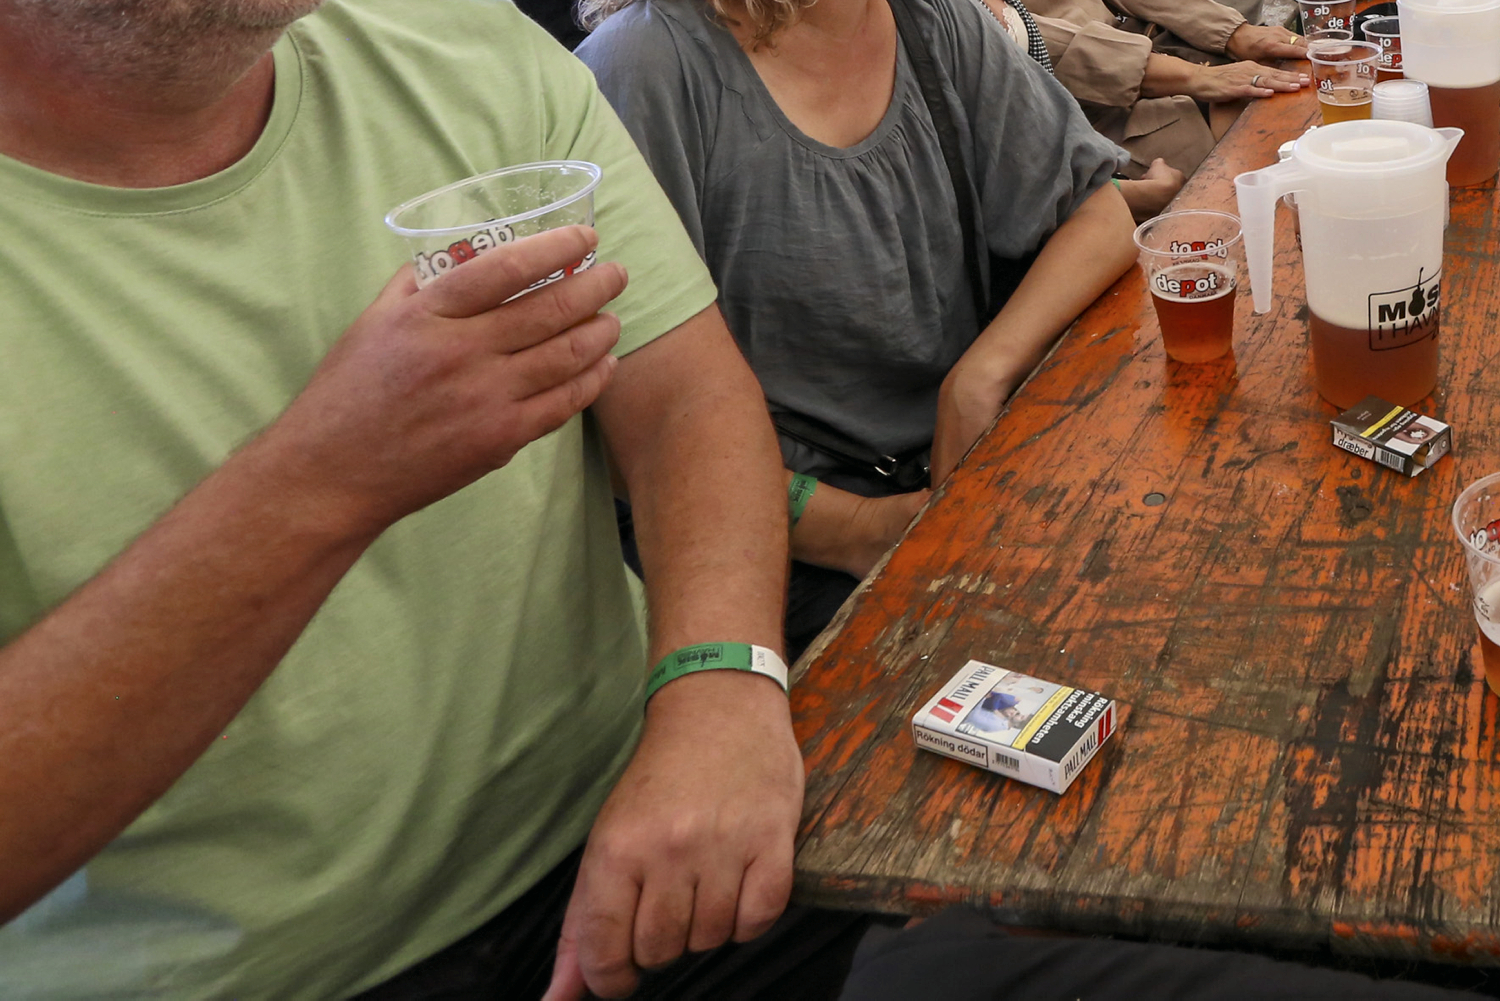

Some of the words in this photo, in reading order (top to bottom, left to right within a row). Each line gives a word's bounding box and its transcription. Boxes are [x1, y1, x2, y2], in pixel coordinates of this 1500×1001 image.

[1156, 271, 1217, 298] depot
[1337, 438, 1369, 458] dræber
[969, 665, 996, 681] PALL
[950, 680, 980, 700] MALL
[1031, 689, 1085, 744] fruktsamheten
[1066, 693, 1095, 723] minskar
[1074, 697, 1108, 728] Rökning
[916, 730, 955, 751] Rökning
[957, 744, 986, 760] dödar
[1064, 752, 1080, 780] PALL
[1080, 732, 1097, 761] MALL
